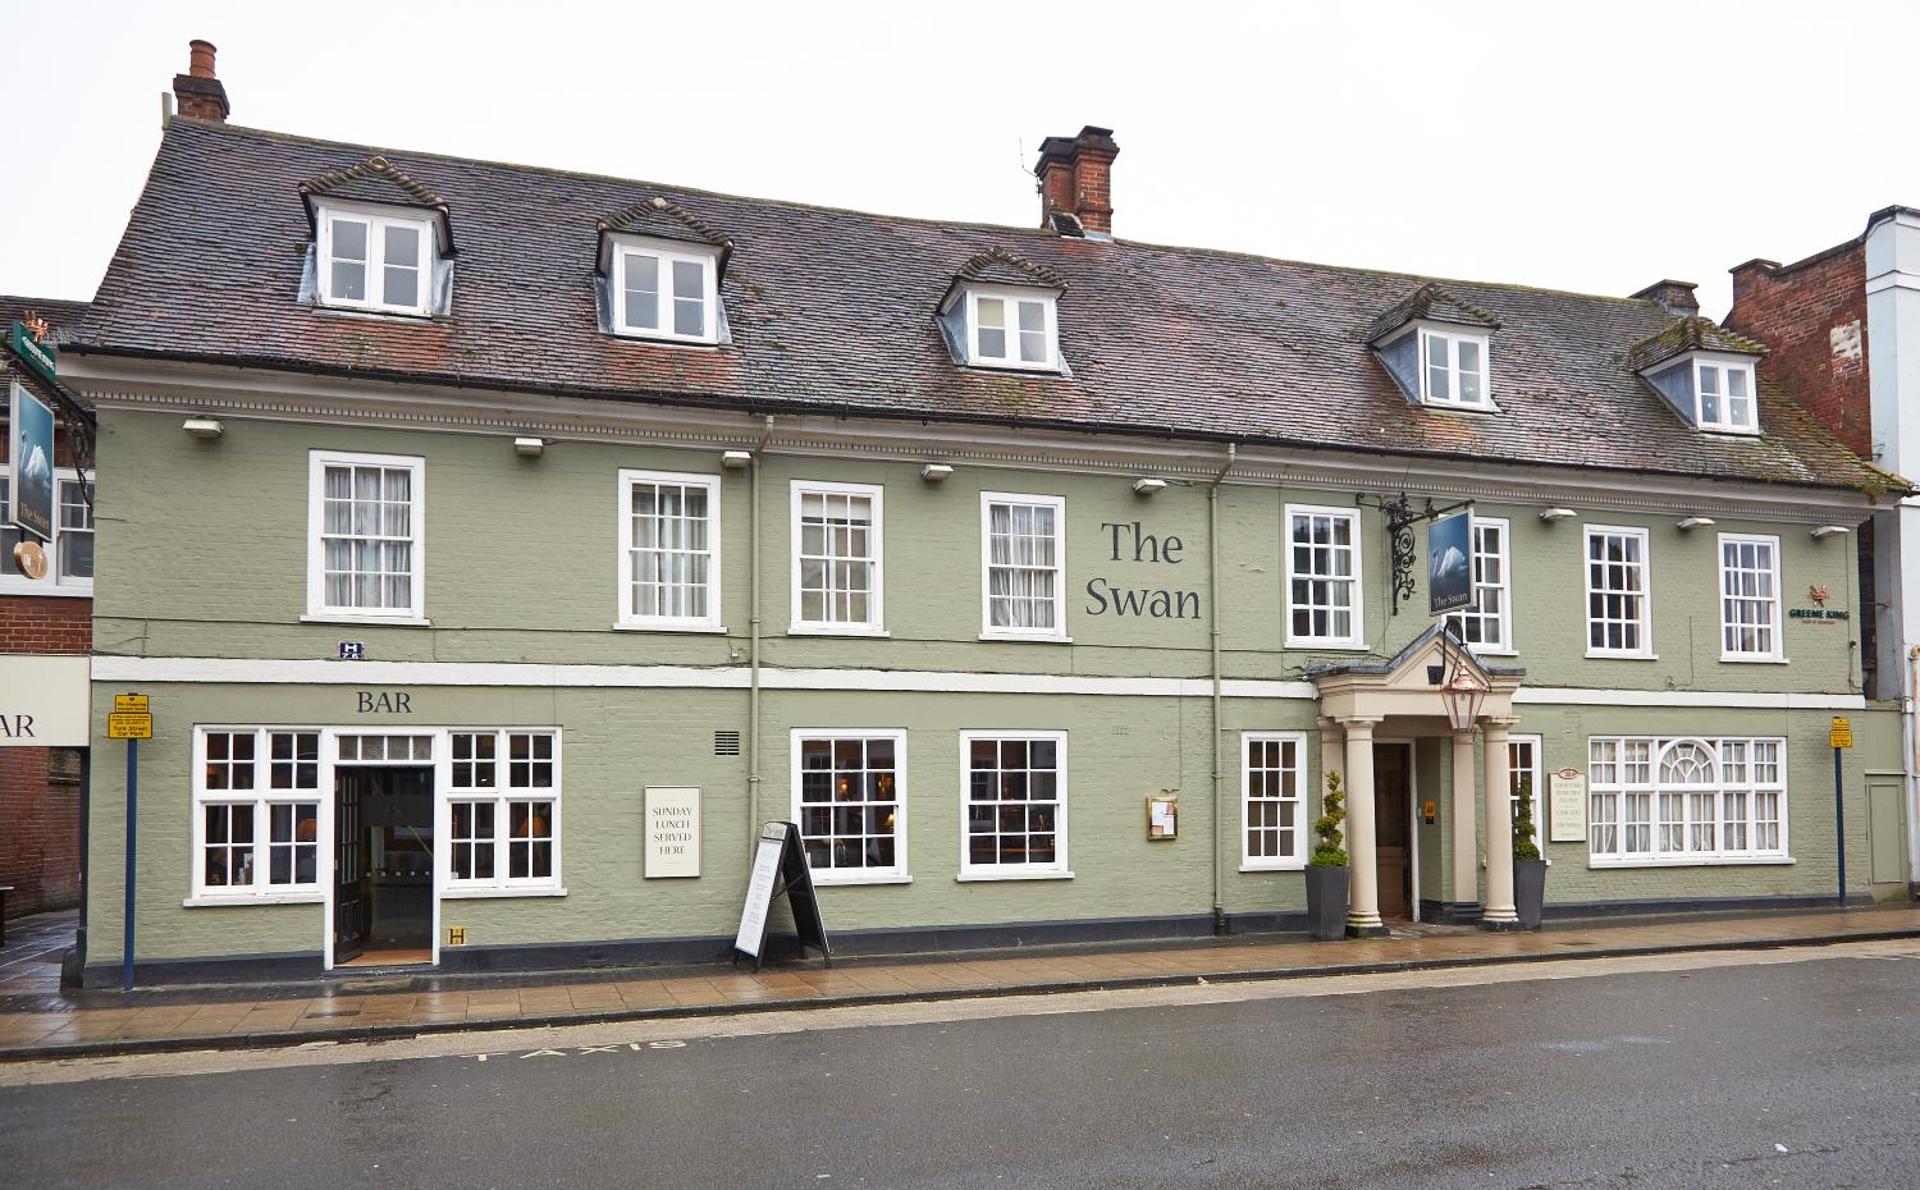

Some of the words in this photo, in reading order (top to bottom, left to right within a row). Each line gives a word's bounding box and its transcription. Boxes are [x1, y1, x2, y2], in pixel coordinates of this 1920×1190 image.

[1101, 521, 1184, 564] The
[1086, 577, 1201, 619] Swan
[1434, 596, 1448, 608] The
[1448, 593, 1468, 606] Swan
[1789, 608, 1825, 619] GREENE
[1826, 609, 1850, 621] KING
[357, 692, 413, 714] BAR
[653, 806, 693, 816] SUNDAY
[656, 820, 690, 829] LUNCH
[653, 833, 692, 842] SERVED
[658, 846, 685, 856] HERE
[450, 928, 464, 944] H
